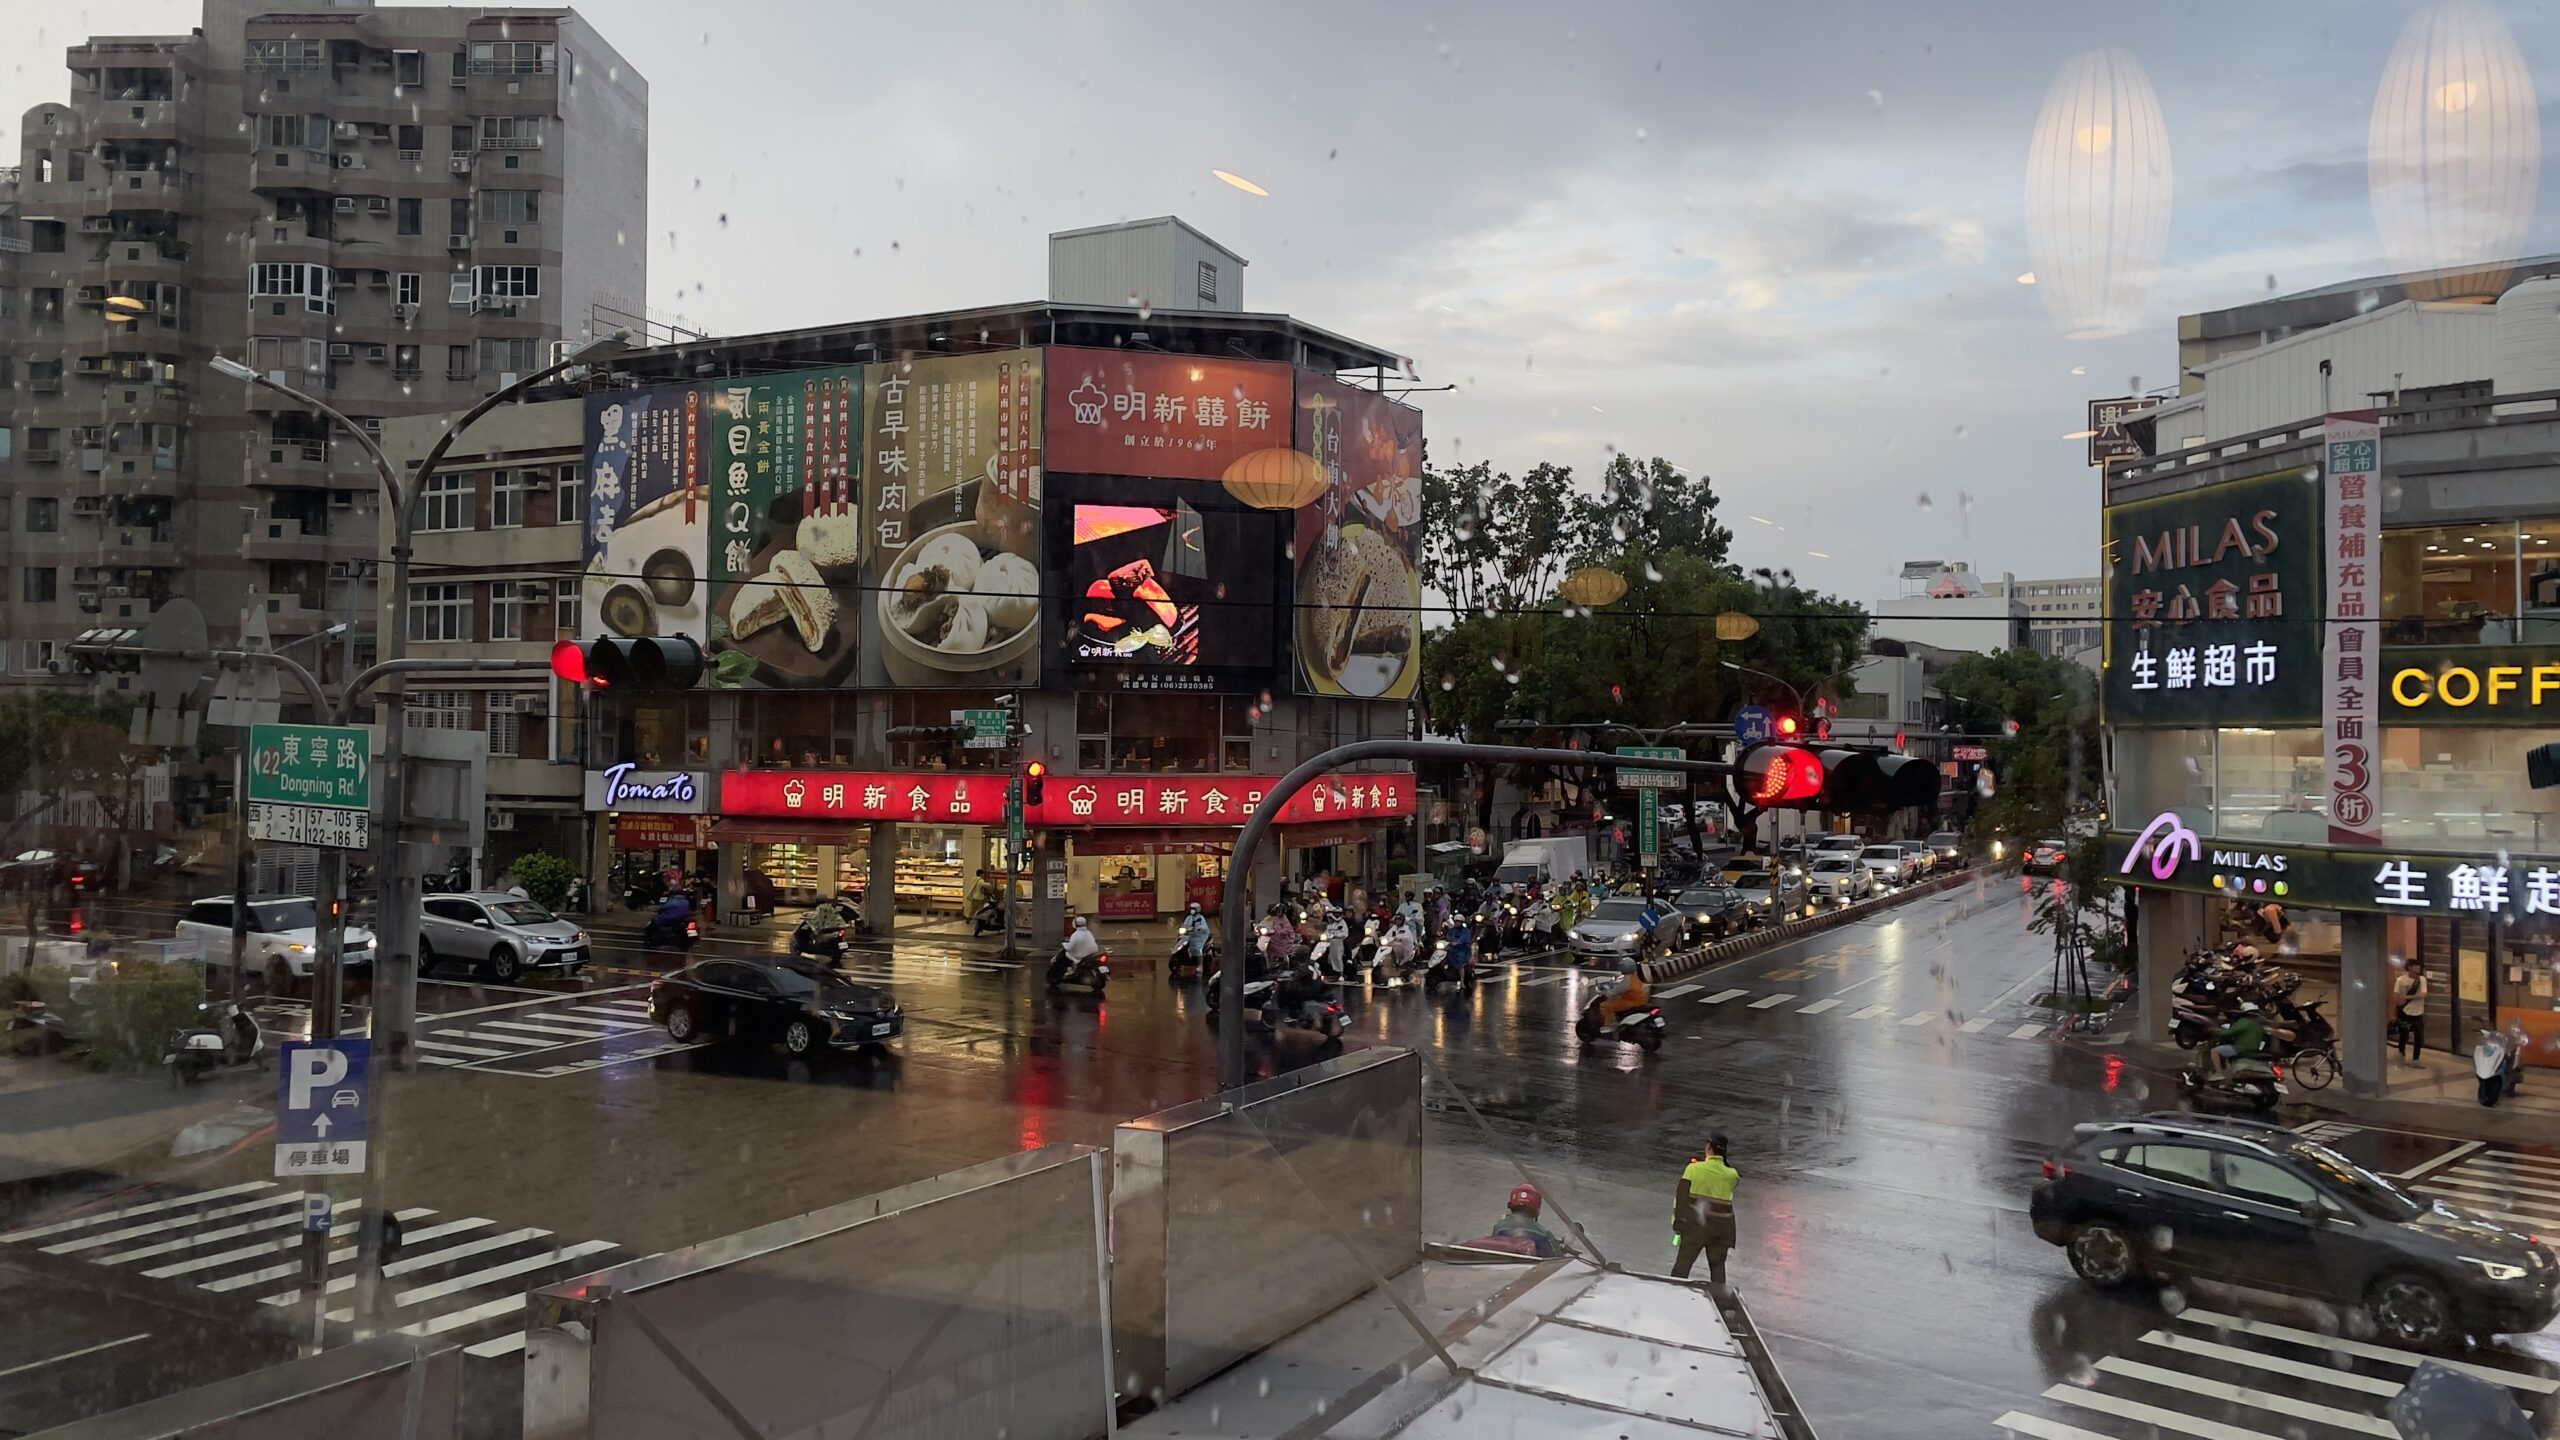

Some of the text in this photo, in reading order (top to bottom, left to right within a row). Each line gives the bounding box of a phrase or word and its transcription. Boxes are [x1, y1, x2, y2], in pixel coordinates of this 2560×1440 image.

[1113, 392, 1271, 430] 明新囍餅
[757, 385, 771, 474] 一兩黃金餅
[1124, 434, 1217, 451] 創立於196年
[2327, 426, 2377, 440] MILAS
[877, 374, 910, 549] 古早味肉包
[2333, 442, 2371, 457] 安心
[2333, 458, 2371, 472] 超市
[590, 404, 626, 542] 黑麻吉
[725, 386, 752, 573] 虱目魚Q餅
[1327, 427, 1339, 550] 台南大餅
[2132, 509, 2279, 574] MILAS
[2337, 475, 2366, 617] 營養補充品
[2131, 572, 2283, 630] 安心食品
[2131, 640, 2278, 689] 生鮮超市
[2391, 666, 2560, 708] COFF
[262, 750, 280, 775] 22
[282, 735, 357, 769] 東寧路
[280, 774, 357, 798] Dongning Rd.
[604, 762, 694, 805] Tomato
[823, 784, 971, 813] 明新食品
[1117, 787, 1261, 814] 明新食品
[1333, 784, 1398, 810] 明新食品
[249, 805, 261, 822] 西
[267, 806, 272, 820] 5
[310, 810, 351, 828] 57-105
[355, 814, 367, 834] 東
[266, 824, 271, 838] 2
[308, 828, 351, 846] 122-186
[2213, 849, 2287, 873] MILAS
[289, 1048, 348, 1110] P
[289, 1149, 350, 1167] 停車場
[303, 1193, 332, 1229] P
